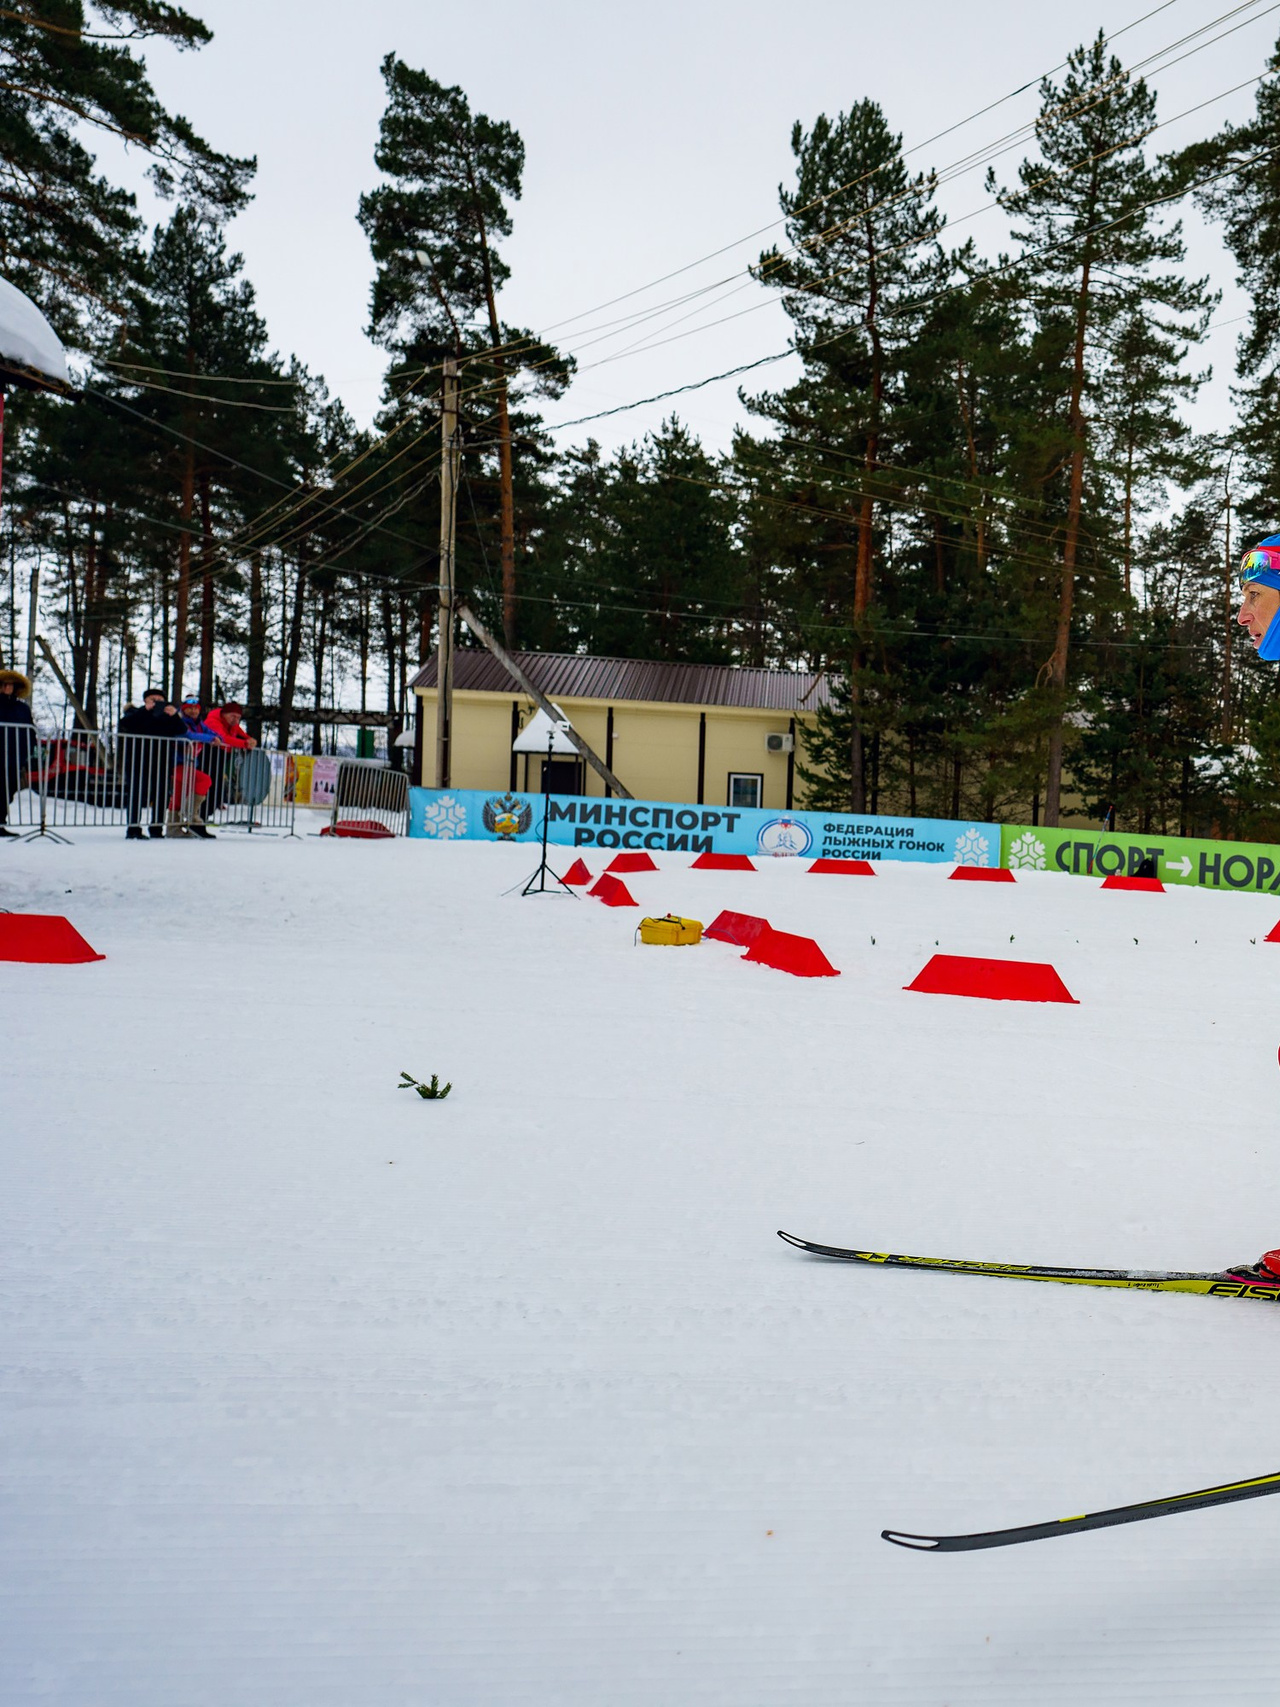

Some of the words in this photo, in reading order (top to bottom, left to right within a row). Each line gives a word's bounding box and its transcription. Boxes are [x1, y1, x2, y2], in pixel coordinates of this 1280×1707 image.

[549, 801, 741, 833] МИНСПОРТ
[574, 827, 714, 853] РОССИИ
[823, 823, 914, 838] ФЕДЕРАЦИЯ
[822, 836, 895, 849] ЛЫЖНЫХ
[899, 840, 945, 853] ГОНОК
[822, 848, 882, 860] РОССИИ
[1055, 841, 1165, 879] СПОРТ
